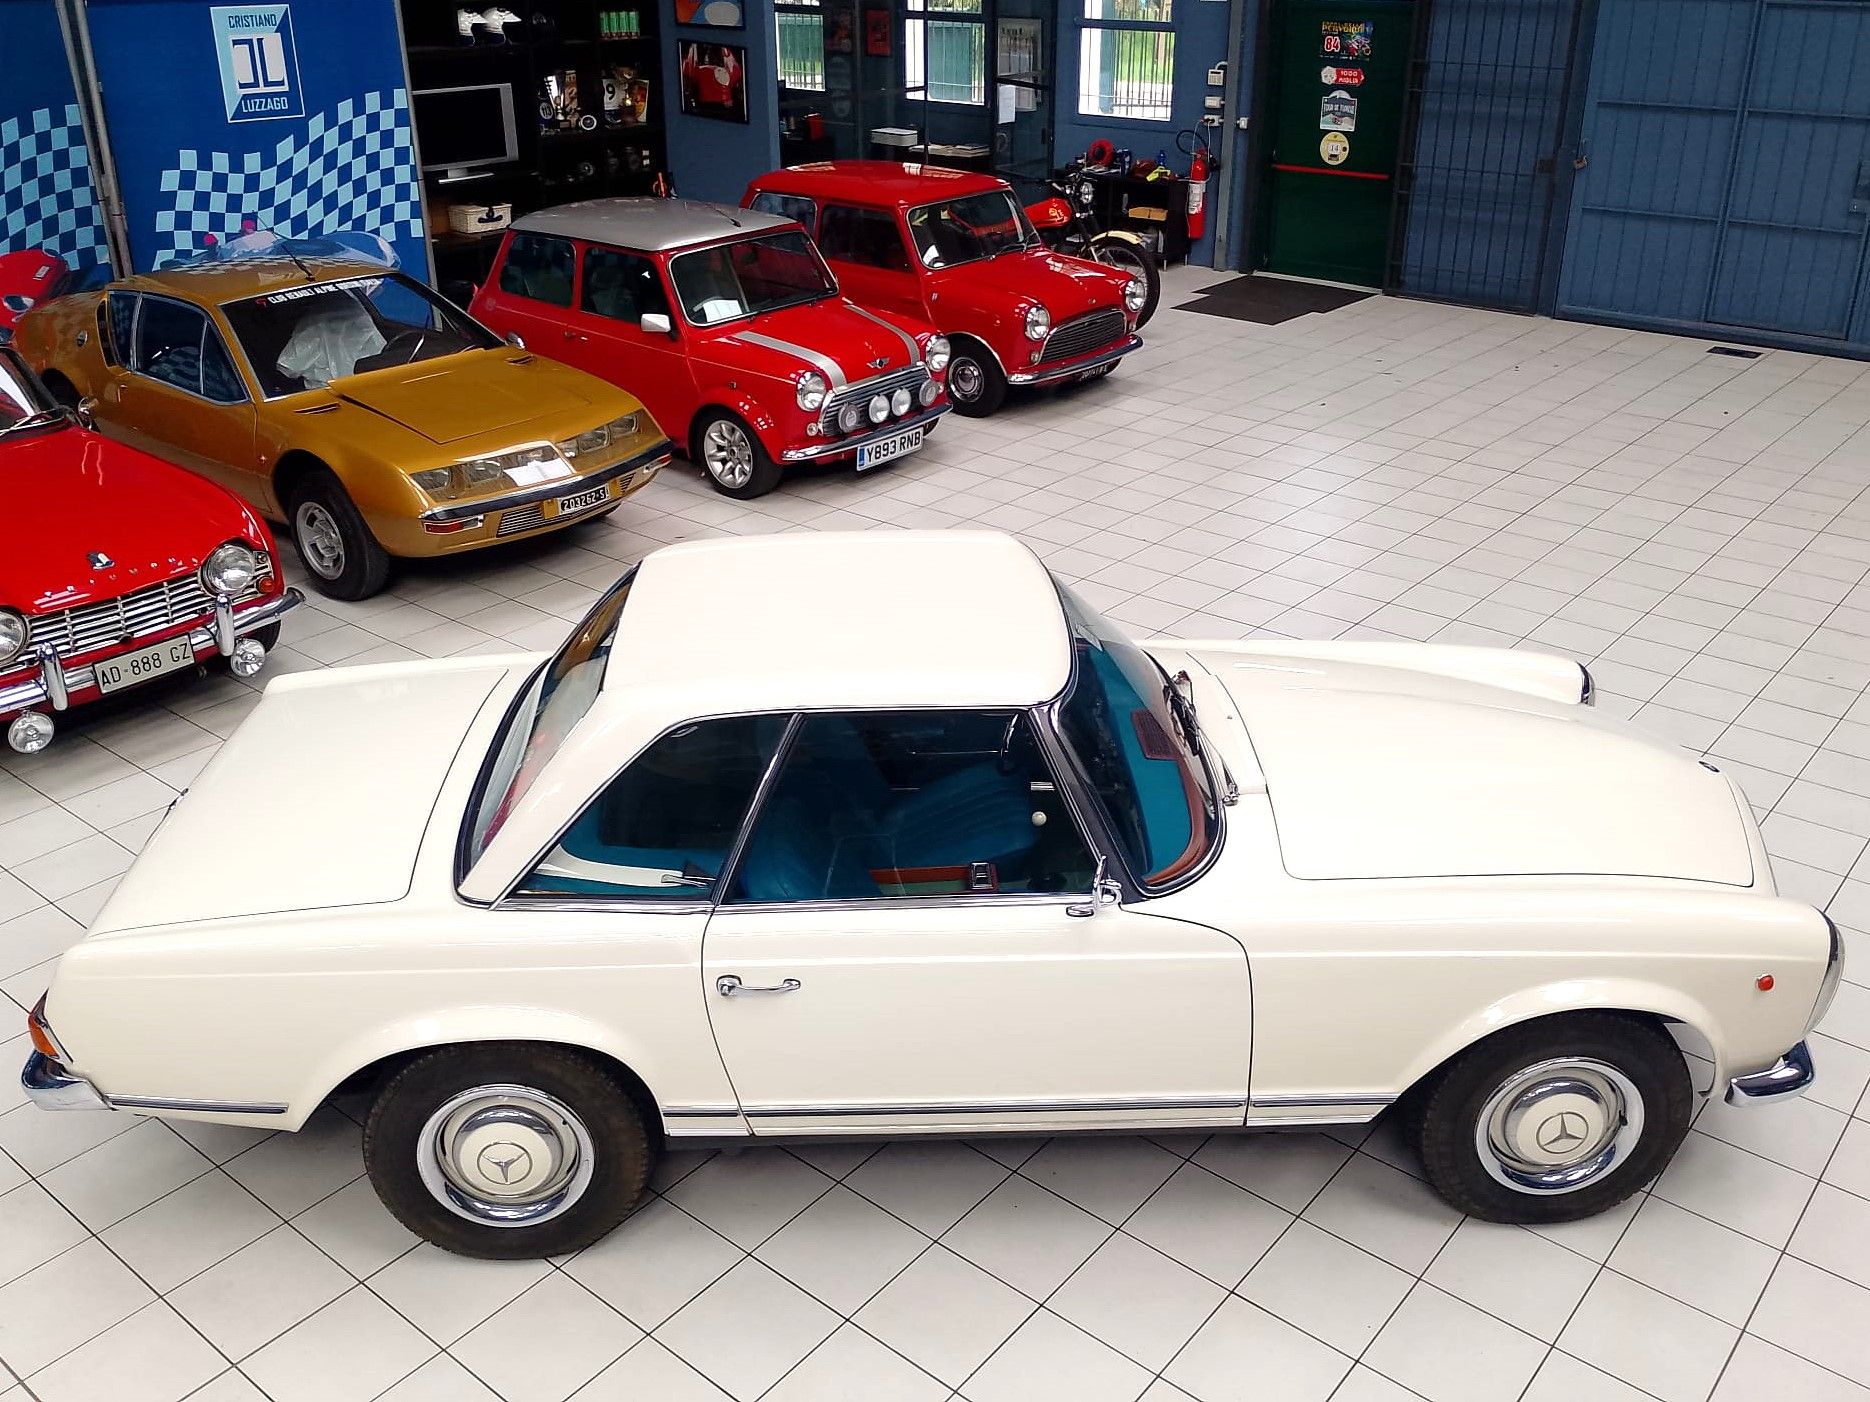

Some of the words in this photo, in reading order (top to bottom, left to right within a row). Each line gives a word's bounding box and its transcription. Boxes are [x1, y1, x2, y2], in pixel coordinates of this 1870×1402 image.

[228, 13, 277, 29] CRISTIANO
[1324, 36, 1341, 52] 84
[605, 83, 616, 101] 9
[242, 97, 288, 113] LUZZAGO
[866, 440, 897, 463] Y893
[899, 431, 921, 452] RNB
[169, 642, 191, 663] GZ
